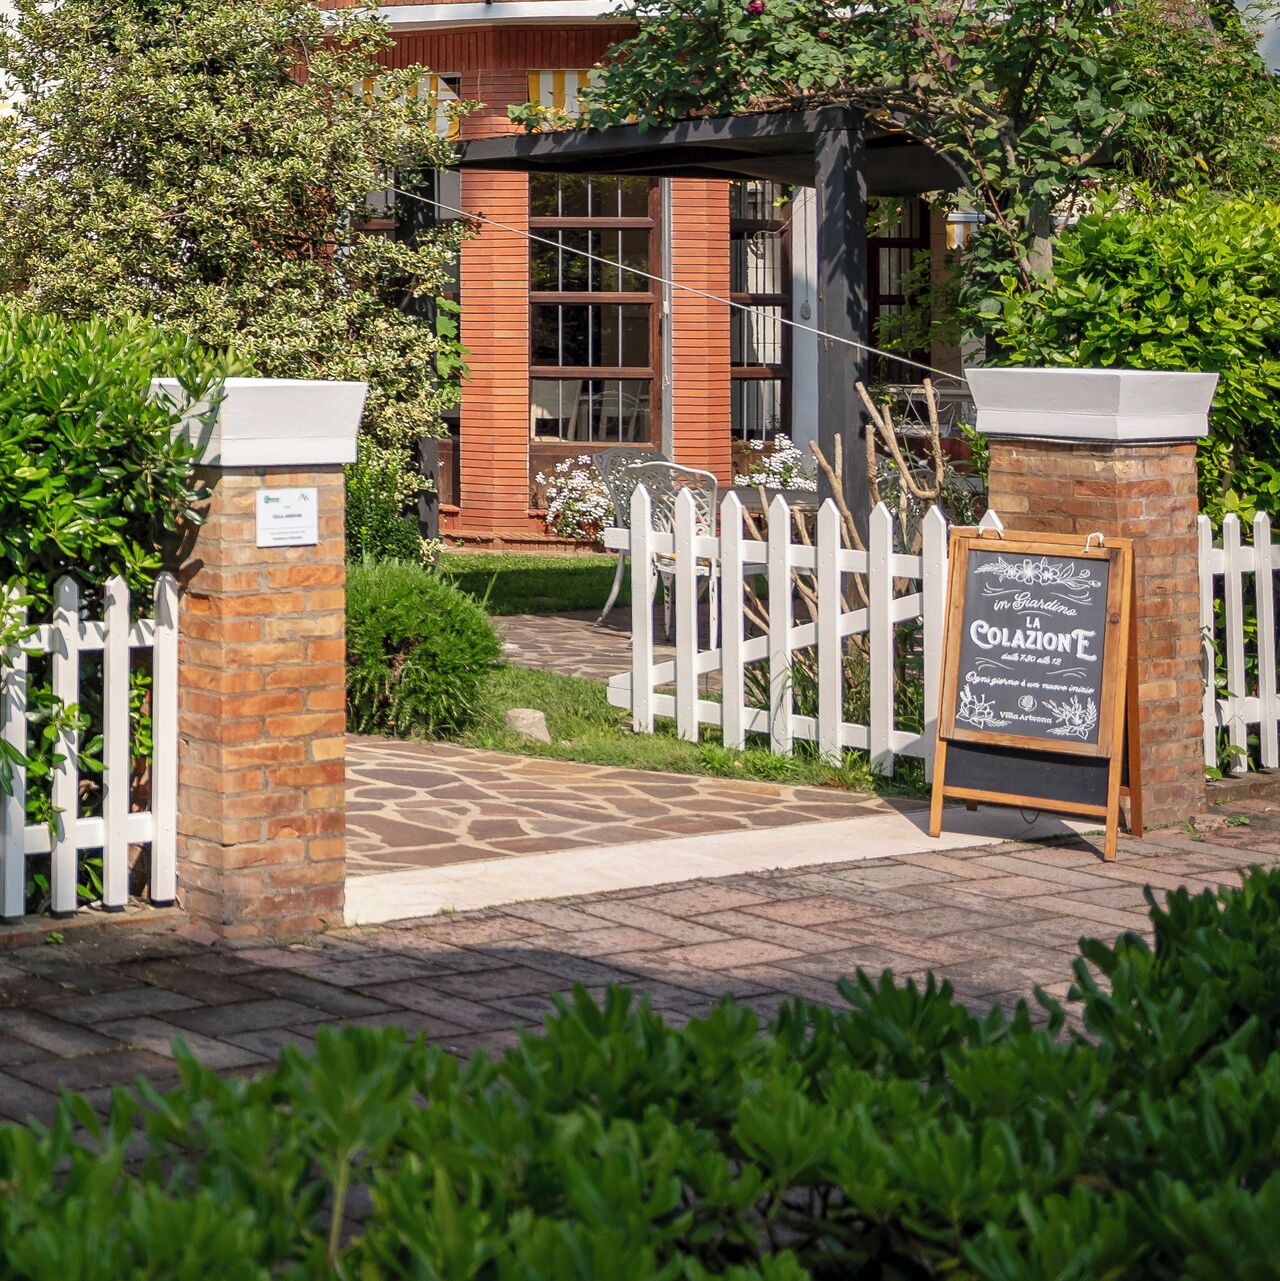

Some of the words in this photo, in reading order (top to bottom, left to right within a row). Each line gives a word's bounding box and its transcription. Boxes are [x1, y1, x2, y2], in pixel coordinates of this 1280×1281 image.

[993, 599, 1012, 611] in
[1013, 592, 1077, 615] Giardino
[1026, 617, 1040, 628] LA
[969, 619, 1098, 662] COLAZIONE
[989, 676, 1020, 687] giorno
[1000, 711, 1018, 720] Villa
[1019, 714, 1052, 724] Arizona
